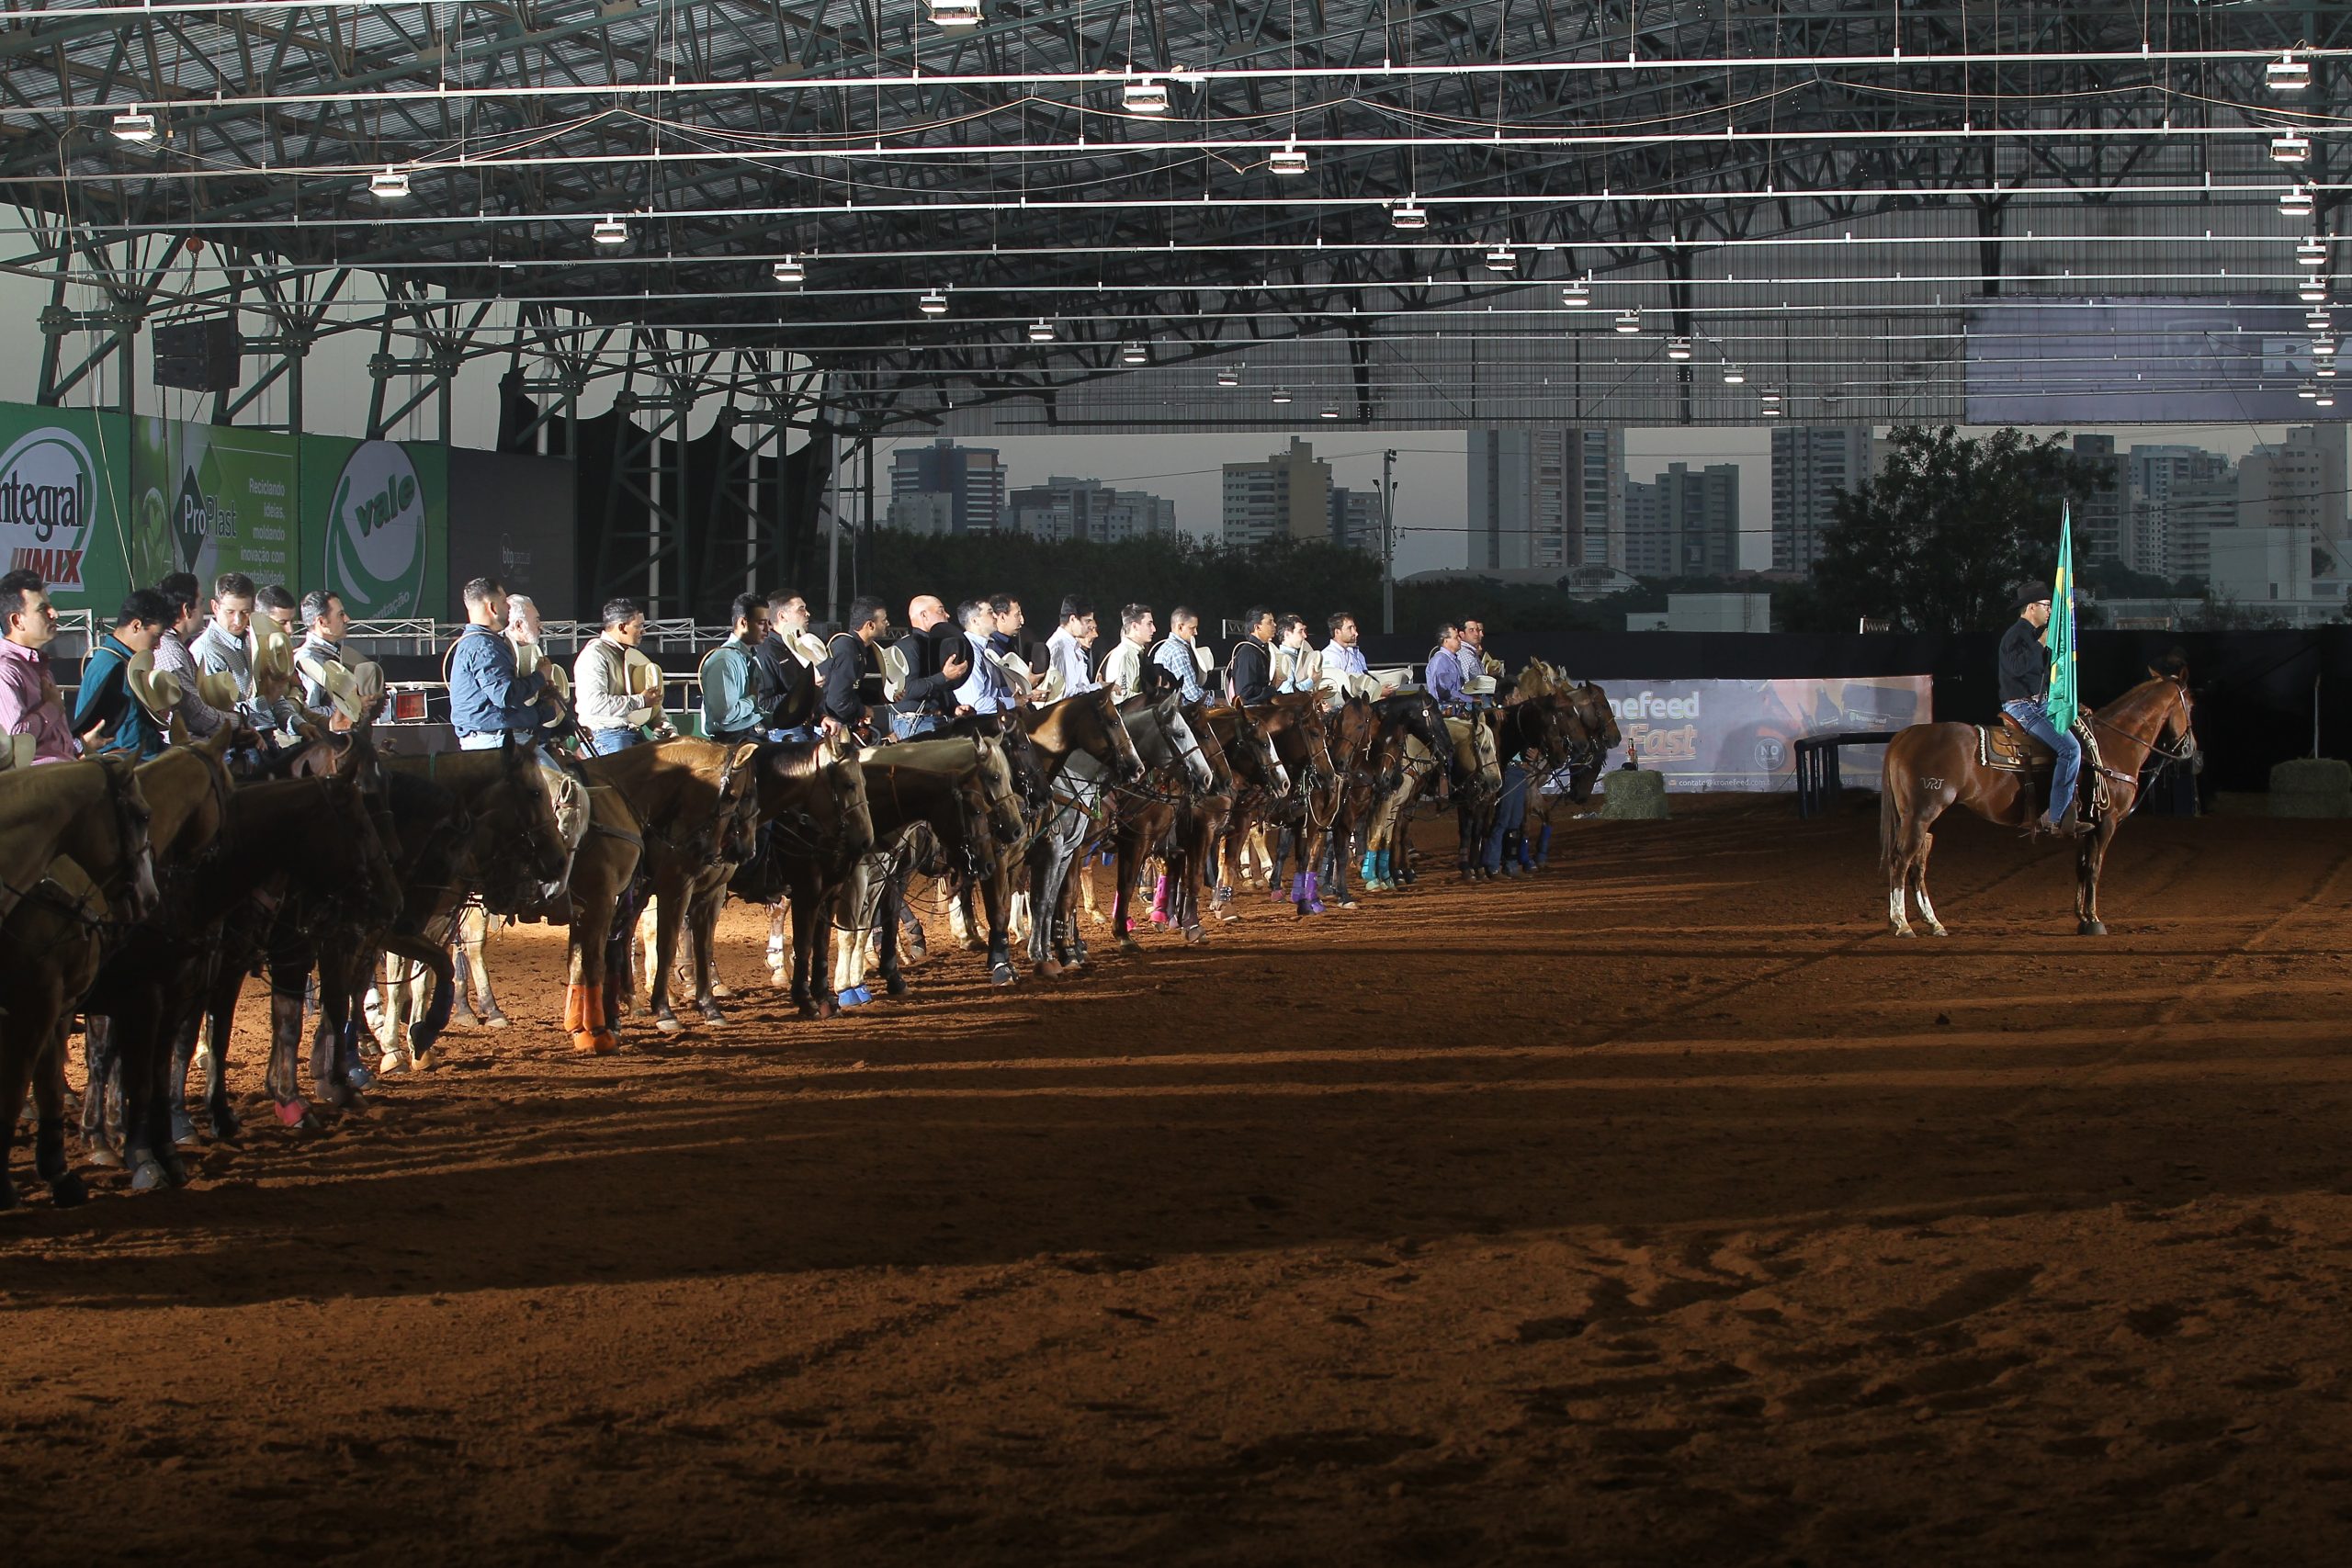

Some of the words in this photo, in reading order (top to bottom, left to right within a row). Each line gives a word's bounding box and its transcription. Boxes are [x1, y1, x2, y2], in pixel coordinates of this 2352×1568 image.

[249, 478, 285, 496] Reciclando
[0, 469, 85, 542] ntegral
[355, 473, 415, 538] vale
[253, 525, 285, 541] moldando
[241, 546, 270, 566] inovação
[271, 550, 285, 564] com
[1607, 690, 1700, 720] nefeed
[1628, 723, 1698, 756] Fast
[1760, 745, 1780, 756] NO
